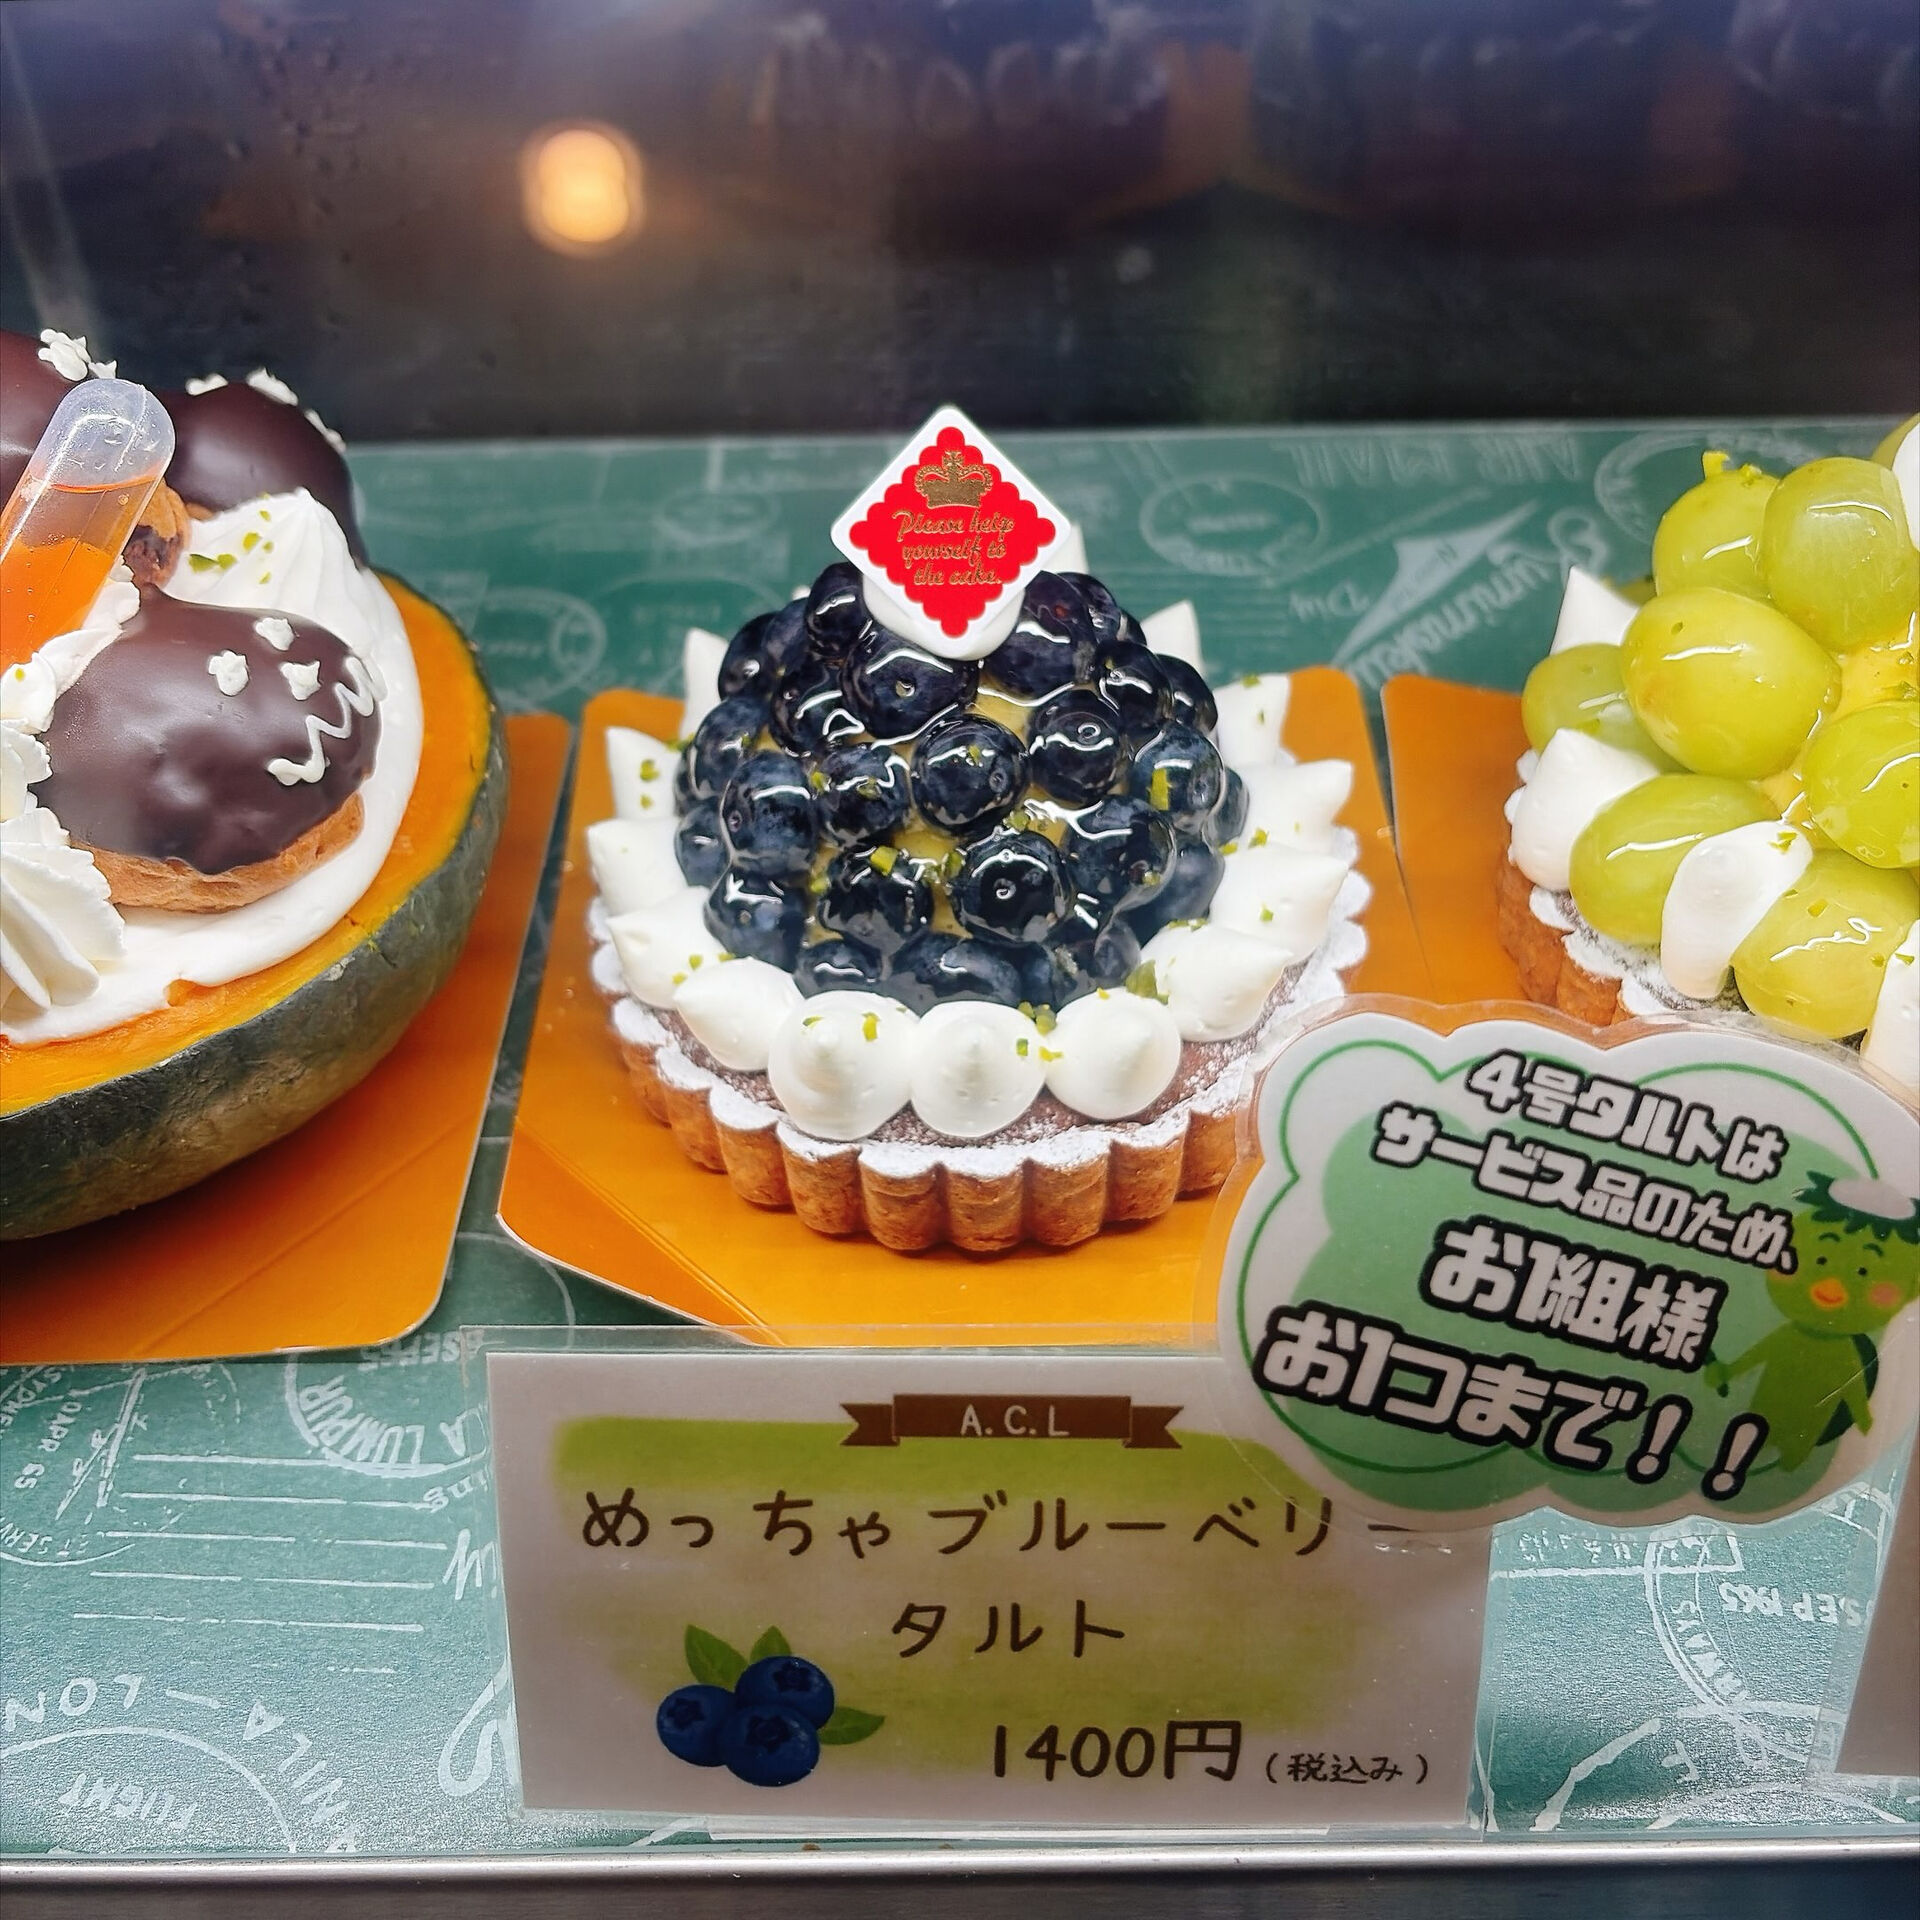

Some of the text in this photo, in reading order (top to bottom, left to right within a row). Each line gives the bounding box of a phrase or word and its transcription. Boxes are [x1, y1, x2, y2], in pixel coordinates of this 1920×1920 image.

[892, 509, 1015, 542] Please help
[902, 536, 1007, 569] yourself to
[913, 562, 1002, 586] the cake.
[1466, 1050, 1789, 1182] 4号タルトは
[1371, 1102, 1798, 1273] サービス品のため、
[0, 1366, 62, 1440] SYDNE
[583, 1487, 1422, 1559] めっちゃブルーベリー
[893, 1600, 1125, 1658] タルト
[994, 1720, 1242, 1781] 1400円
